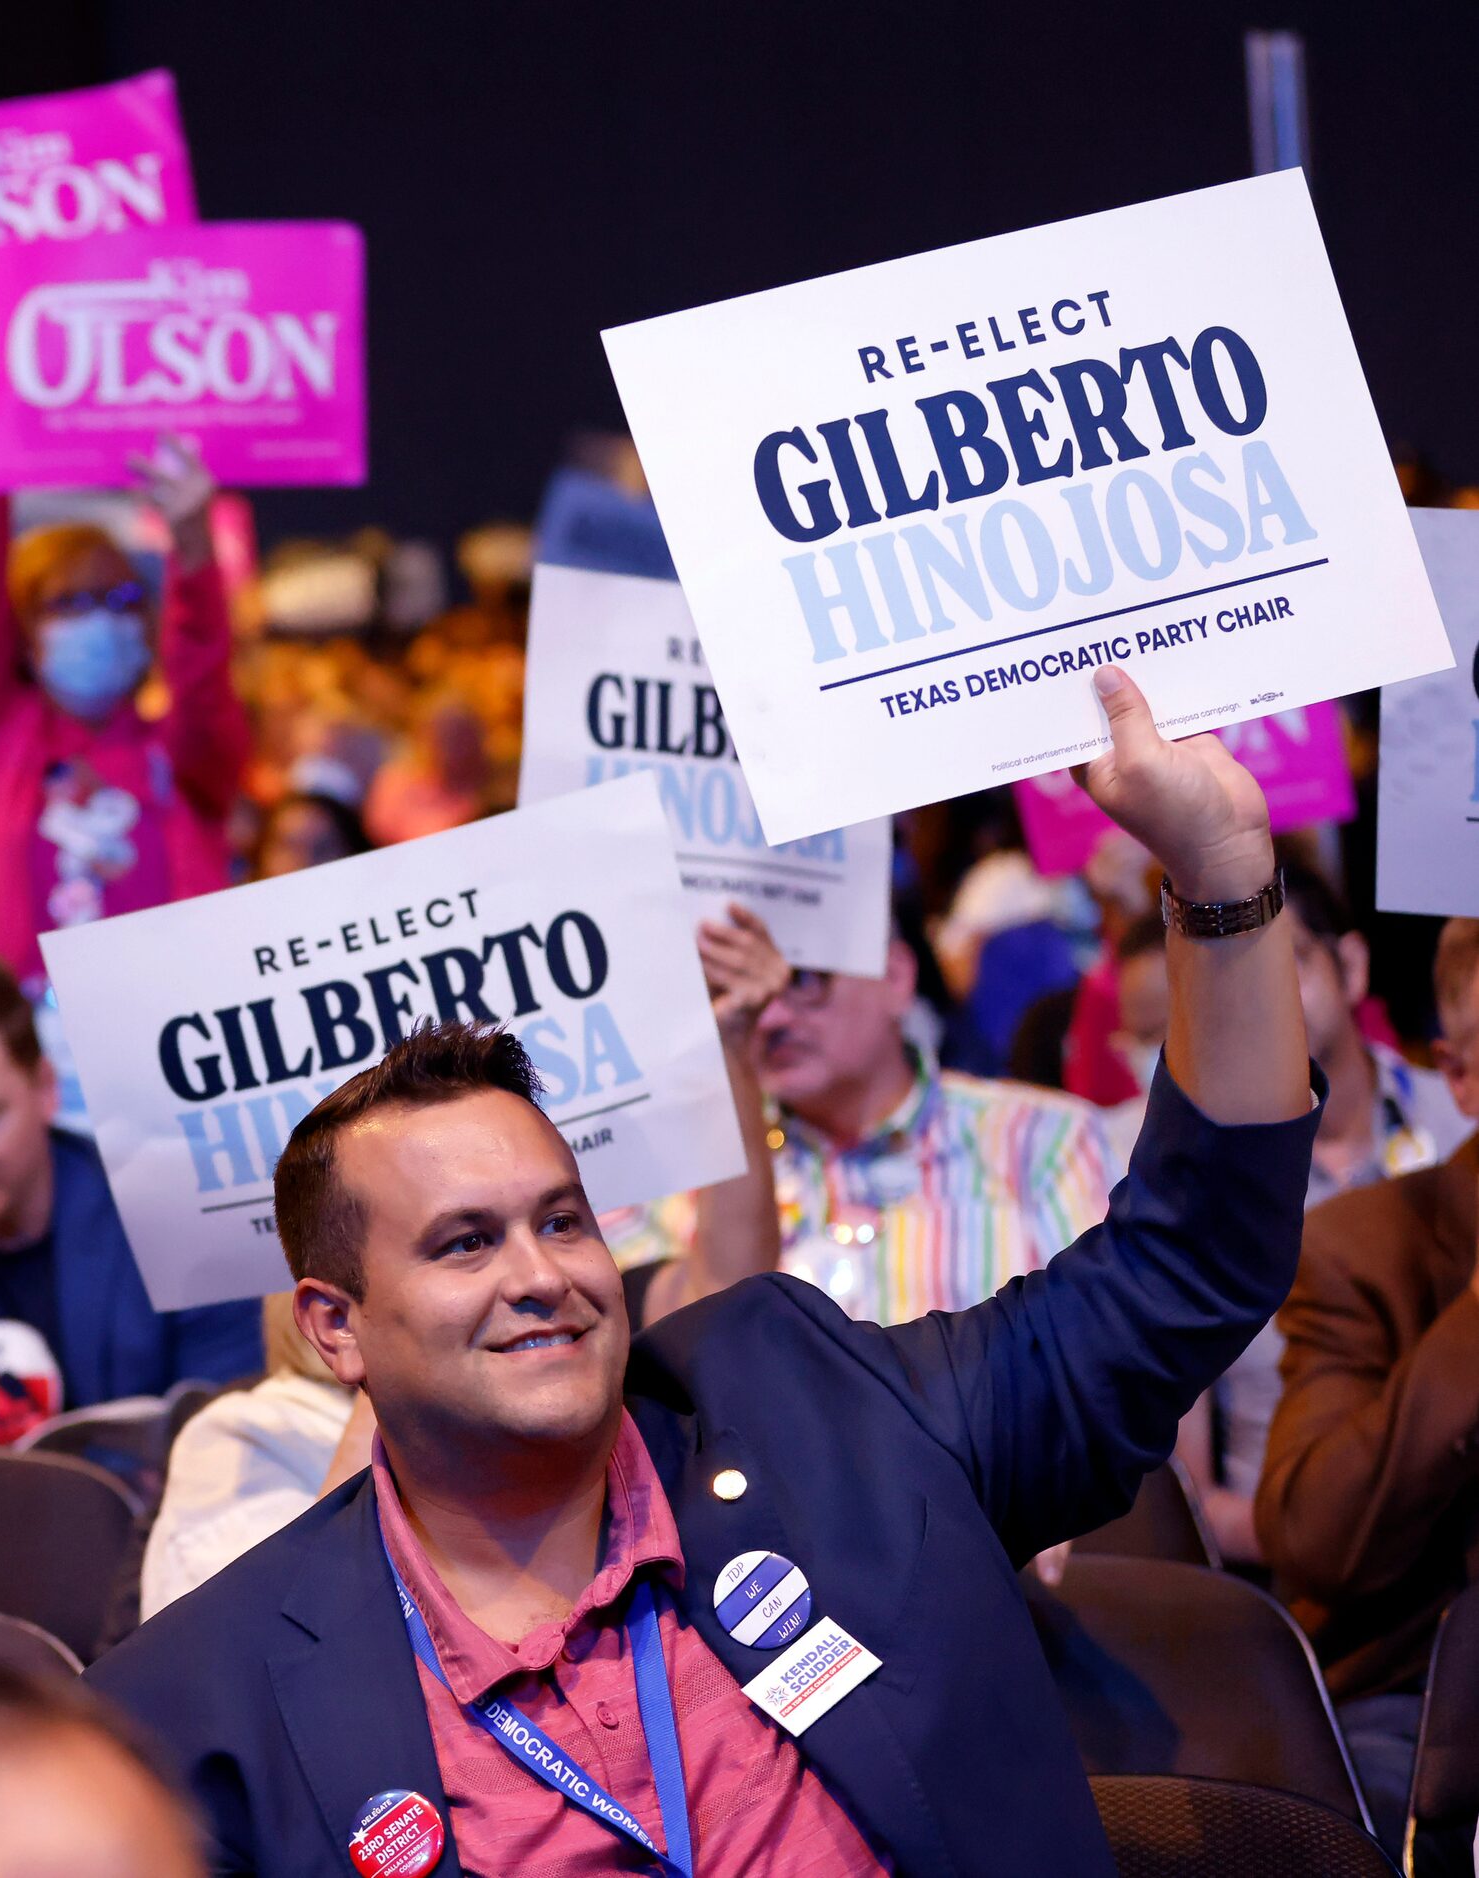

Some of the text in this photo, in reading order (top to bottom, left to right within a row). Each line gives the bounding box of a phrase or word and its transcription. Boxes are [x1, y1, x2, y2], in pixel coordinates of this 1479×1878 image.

[7, 284, 337, 407] OLSON
[857, 289, 1116, 384] RE-ELECT
[754, 325, 1268, 542] GILBERTO
[781, 440, 1319, 664] HINOJOSA
[880, 596, 1295, 718] TEXAS DEMOCRATIC PARTY CHAIR
[991, 757, 1022, 772] Political
[1023, 744, 1078, 763] advertisement
[1079, 738, 1097, 752] paid
[1166, 712, 1200, 727] Hinojosa
[254, 889, 482, 977] RE-ELECT
[726, 1562, 744, 1583] TDP
[745, 1580, 763, 1600] WE
[762, 1596, 783, 1618] CAN
[777, 1612, 802, 1639] WIN!
[780, 1633, 842, 1684] KENDALL
[790, 1639, 852, 1693] SCUDDER
[484, 1702, 590, 1797] DEMOCRATIC
[357, 1803, 424, 1862] 23RD SENATE
[360, 1798, 393, 1826] DELEGATE
[375, 1823, 422, 1864] DISTRICT
[383, 1858, 404, 1876] DALLAS
